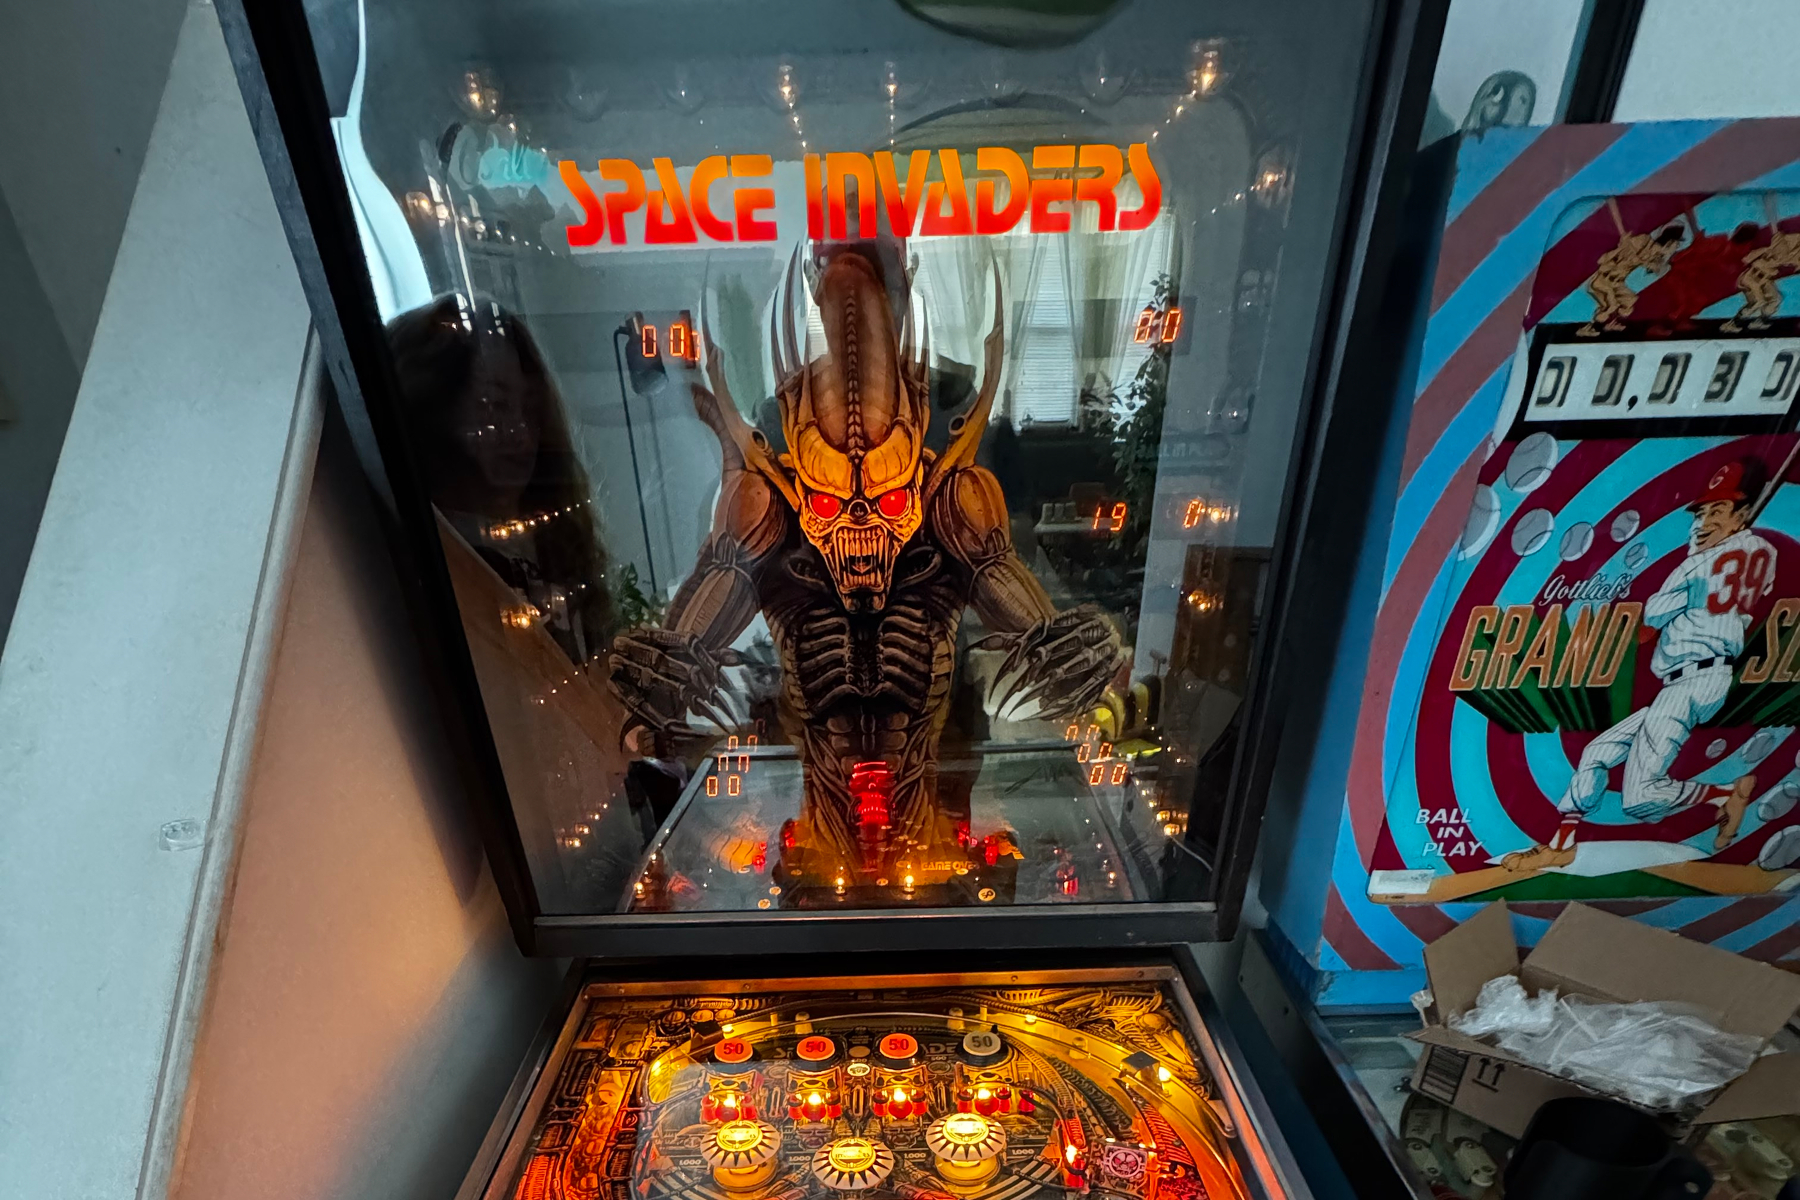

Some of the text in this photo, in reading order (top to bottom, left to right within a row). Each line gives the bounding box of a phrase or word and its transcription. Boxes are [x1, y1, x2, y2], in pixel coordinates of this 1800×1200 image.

[558, 155, 778, 247] SPACE
[804, 143, 1162, 241] INVADERS
[1538, 573, 1633, 607] Gottlieb's
[1706, 548, 1771, 616] 39
[1449, 595, 1800, 692] GRAND SL
[1416, 808, 1472, 825] BALL
[1436, 826, 1465, 839] IN
[1422, 840, 1484, 857] PLAY
[722, 1041, 745, 1056] 50
[805, 1040, 827, 1053] 50
[888, 1038, 910, 1051] 50
[971, 1034, 993, 1048] 50
